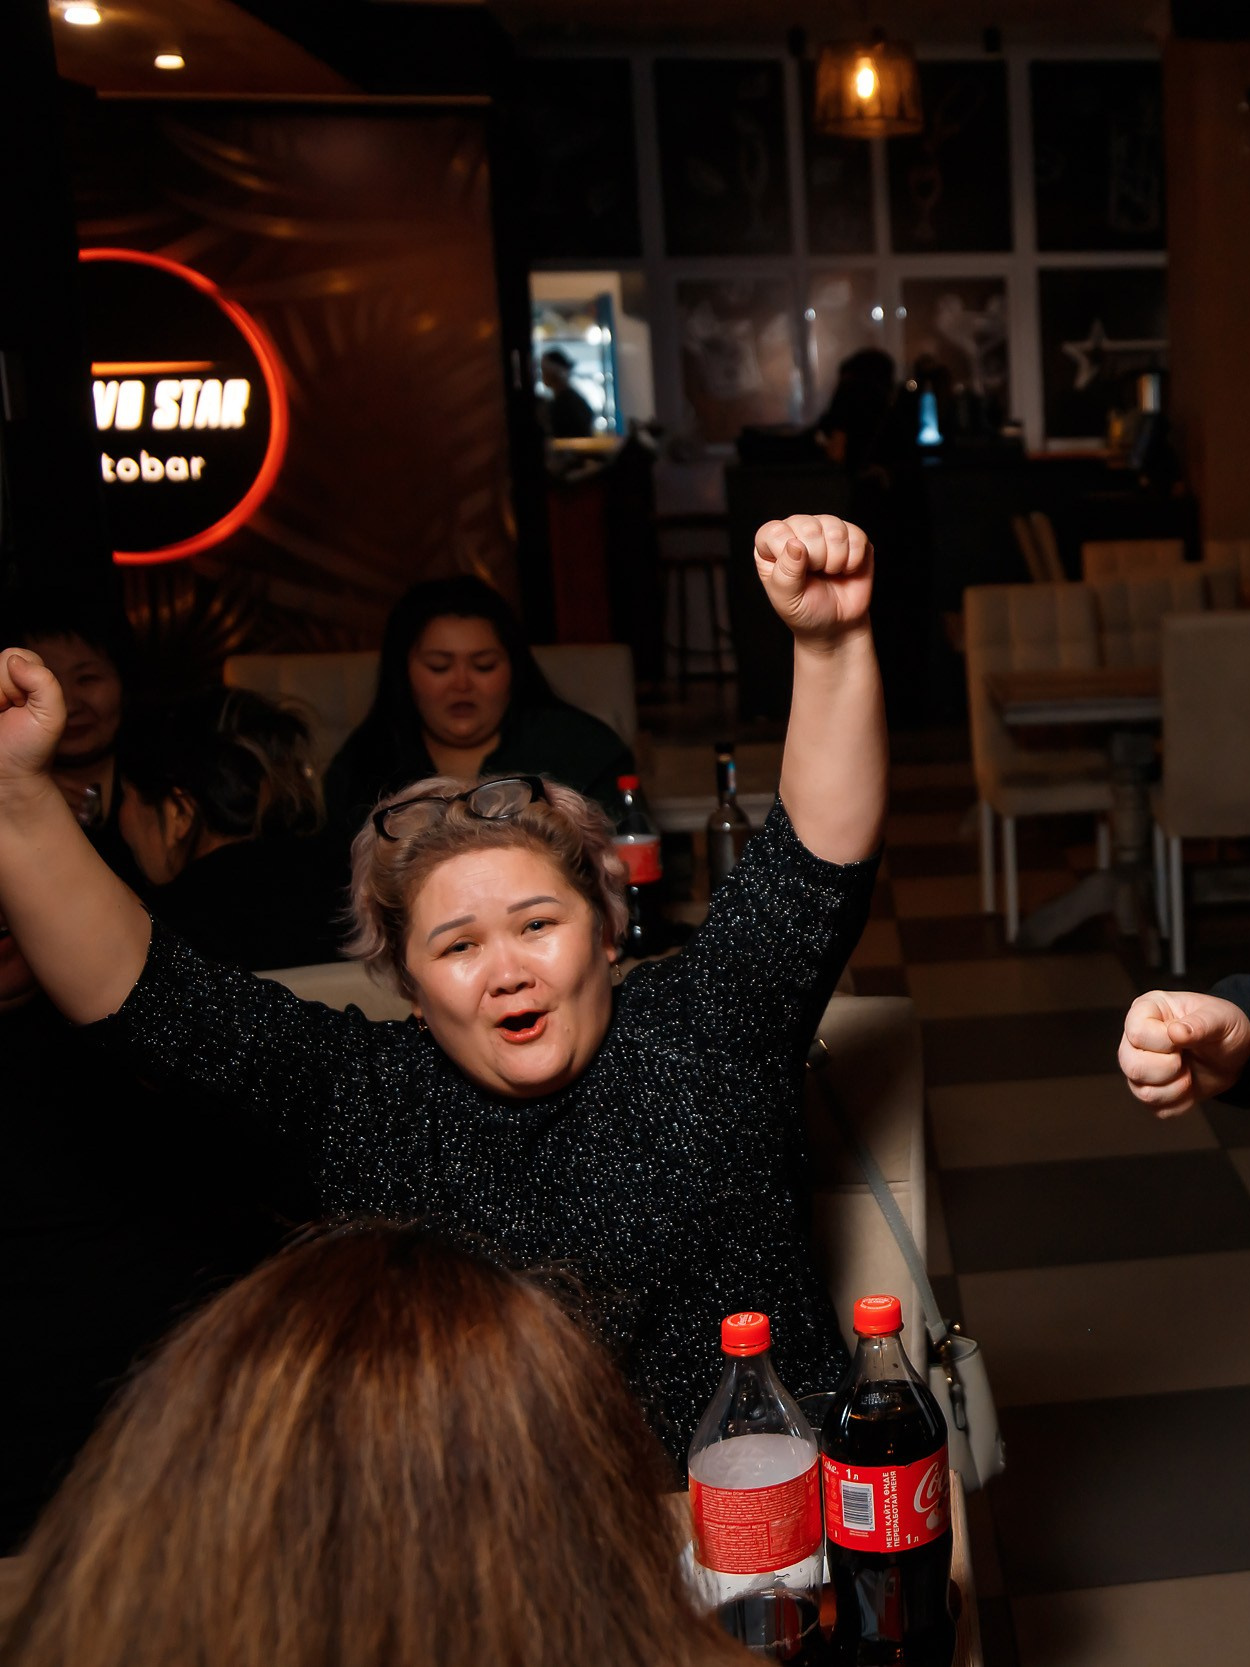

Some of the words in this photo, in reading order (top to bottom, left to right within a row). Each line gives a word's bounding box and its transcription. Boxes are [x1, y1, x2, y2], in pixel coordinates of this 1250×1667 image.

[152, 378, 250, 430] STAR
[101, 449, 205, 482] tobar
[846, 1468, 851, 1479] 1
[890, 1493, 900, 1547] ПЕРЕРАБОТАЙ
[905, 1533, 911, 1544] 1
